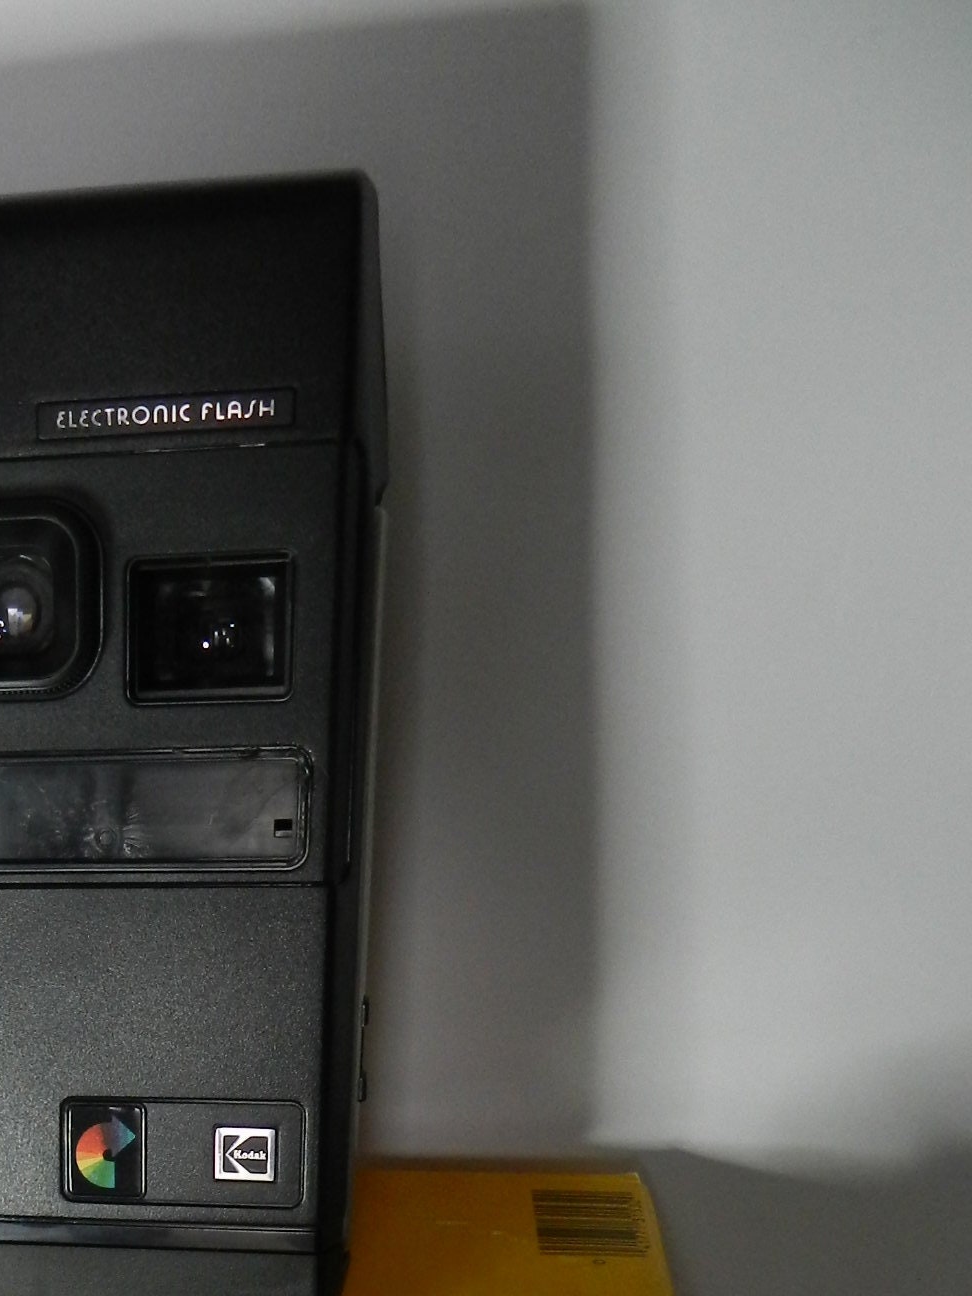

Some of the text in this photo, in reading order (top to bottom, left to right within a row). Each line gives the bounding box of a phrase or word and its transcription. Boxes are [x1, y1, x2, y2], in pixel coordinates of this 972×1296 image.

[56, 399, 275, 429] ELECTRONIC FLASH
[233, 1149, 267, 1161] Kodak
